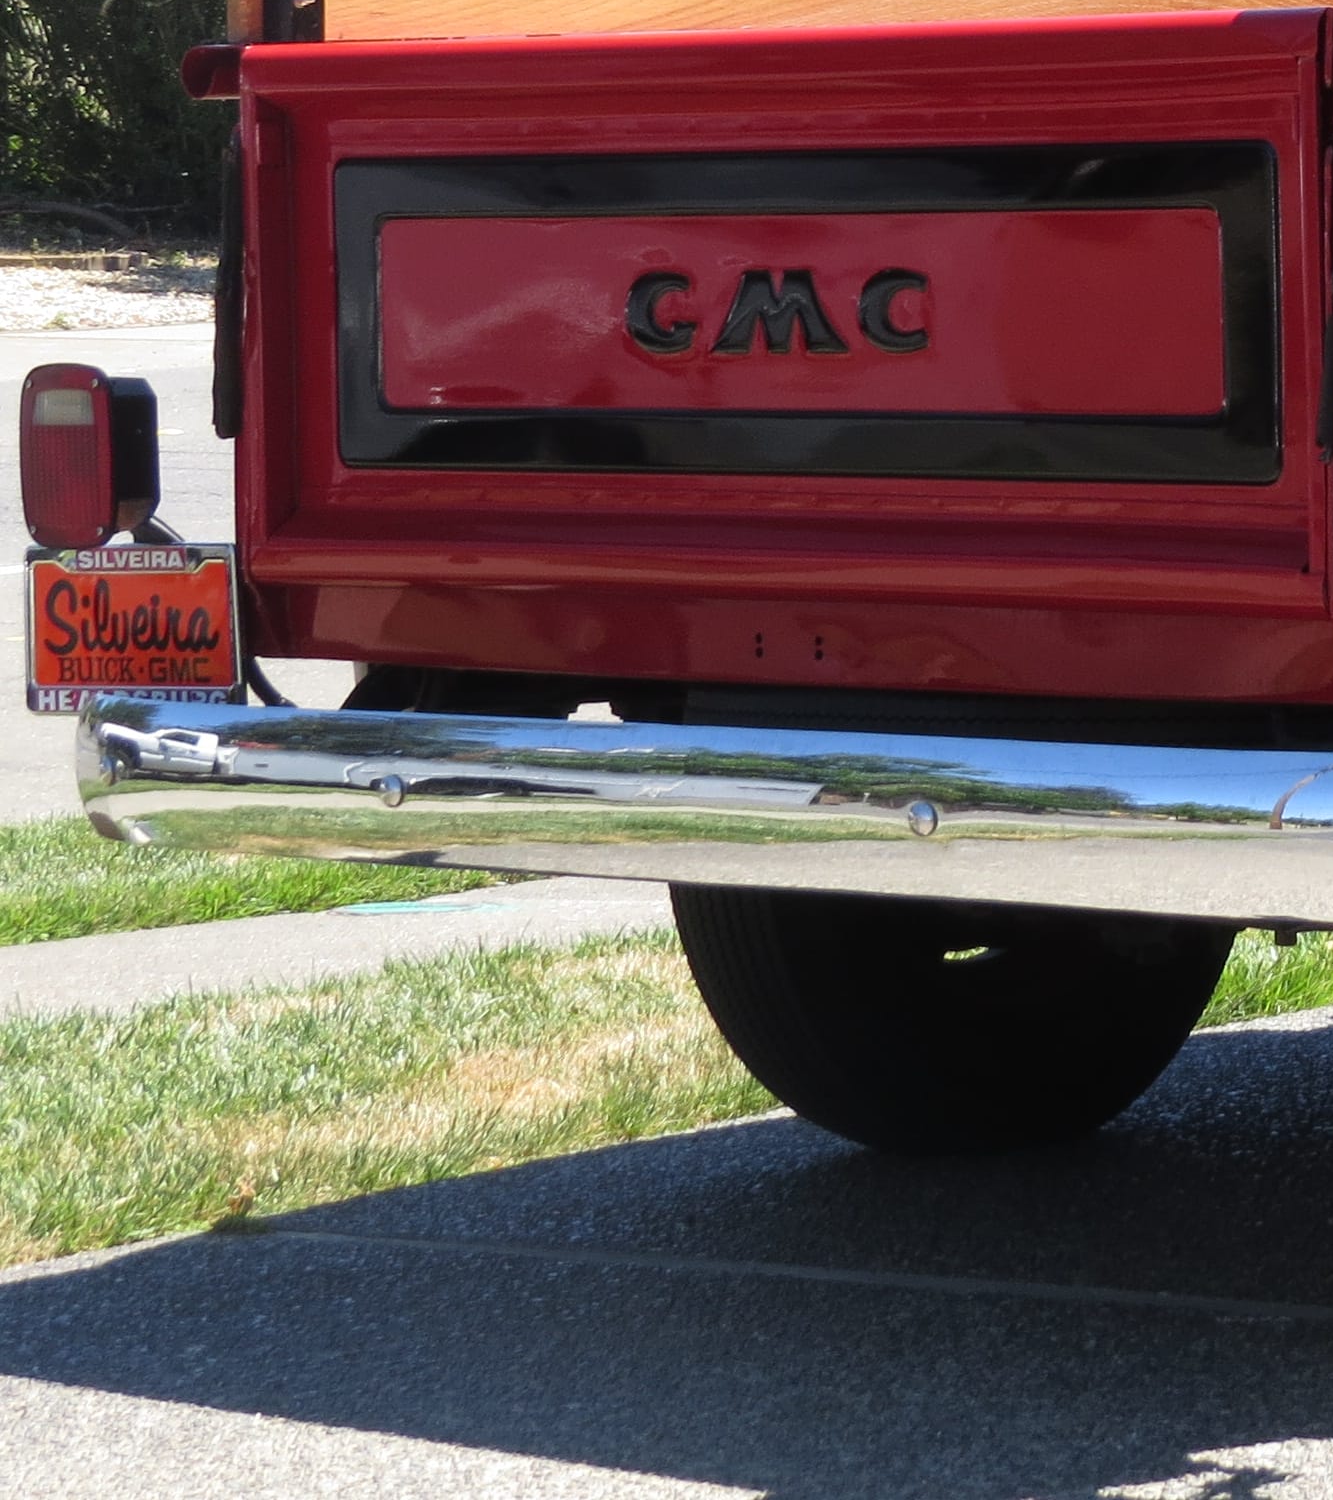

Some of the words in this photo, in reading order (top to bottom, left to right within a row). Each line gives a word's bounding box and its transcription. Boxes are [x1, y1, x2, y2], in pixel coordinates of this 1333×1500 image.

[625, 268, 930, 355] GMC
[77, 549, 184, 569] SILVEIRA
[44, 579, 220, 655] Silveira
[58, 656, 136, 683] BUICK
[148, 656, 213, 683] GMC
